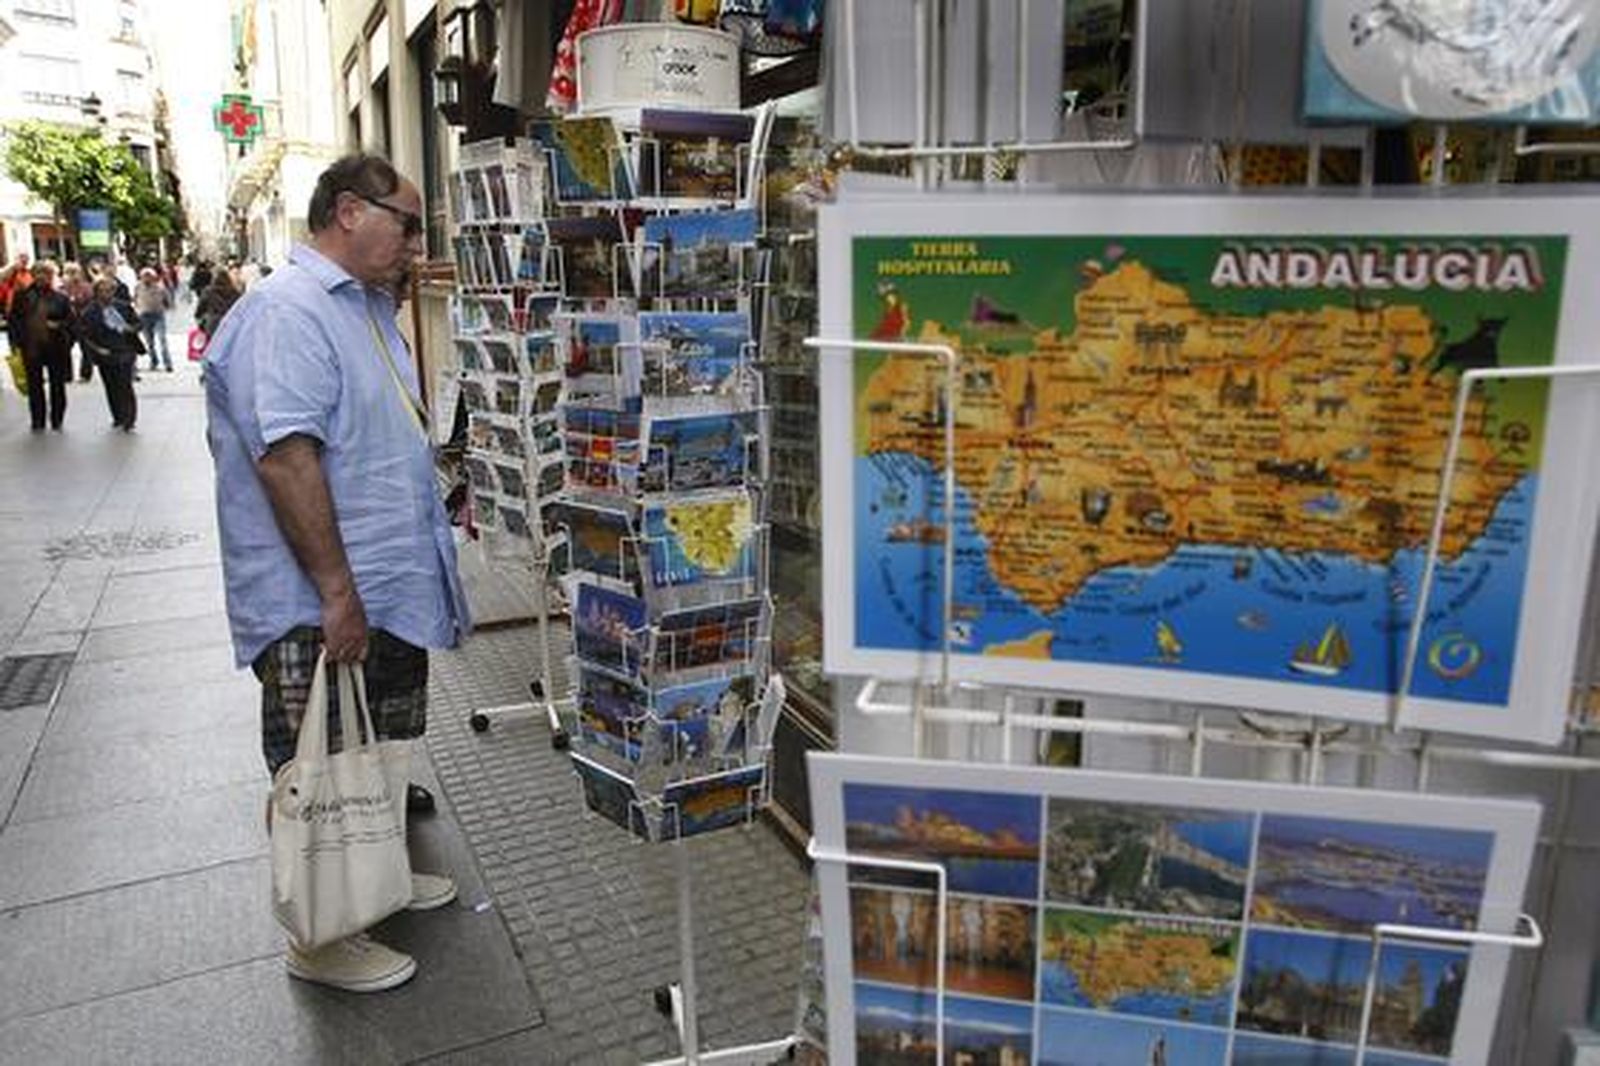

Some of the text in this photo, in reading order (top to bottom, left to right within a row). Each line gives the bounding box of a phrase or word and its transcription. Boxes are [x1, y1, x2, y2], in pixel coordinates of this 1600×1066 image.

[909, 242, 977, 256] TIERRA
[878, 259, 1011, 275] HOSPITALARIA
[1210, 244, 1541, 290] ANDALUCIA
